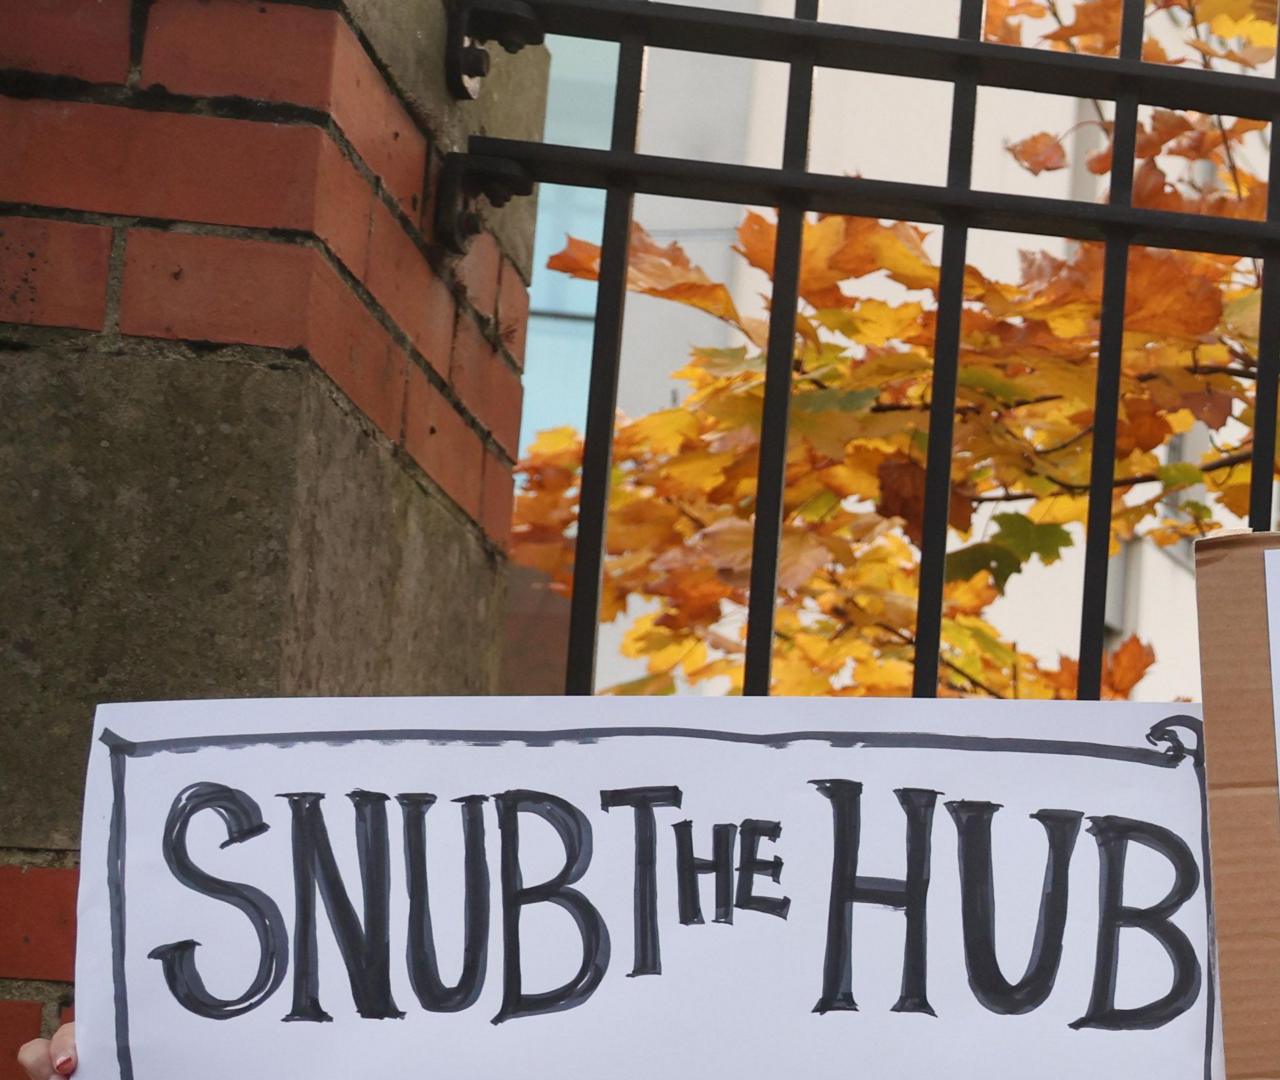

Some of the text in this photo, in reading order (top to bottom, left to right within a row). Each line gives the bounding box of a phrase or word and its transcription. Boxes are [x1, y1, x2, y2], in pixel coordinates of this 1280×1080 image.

[148, 778, 1203, 1030] SNUB THE HUB
